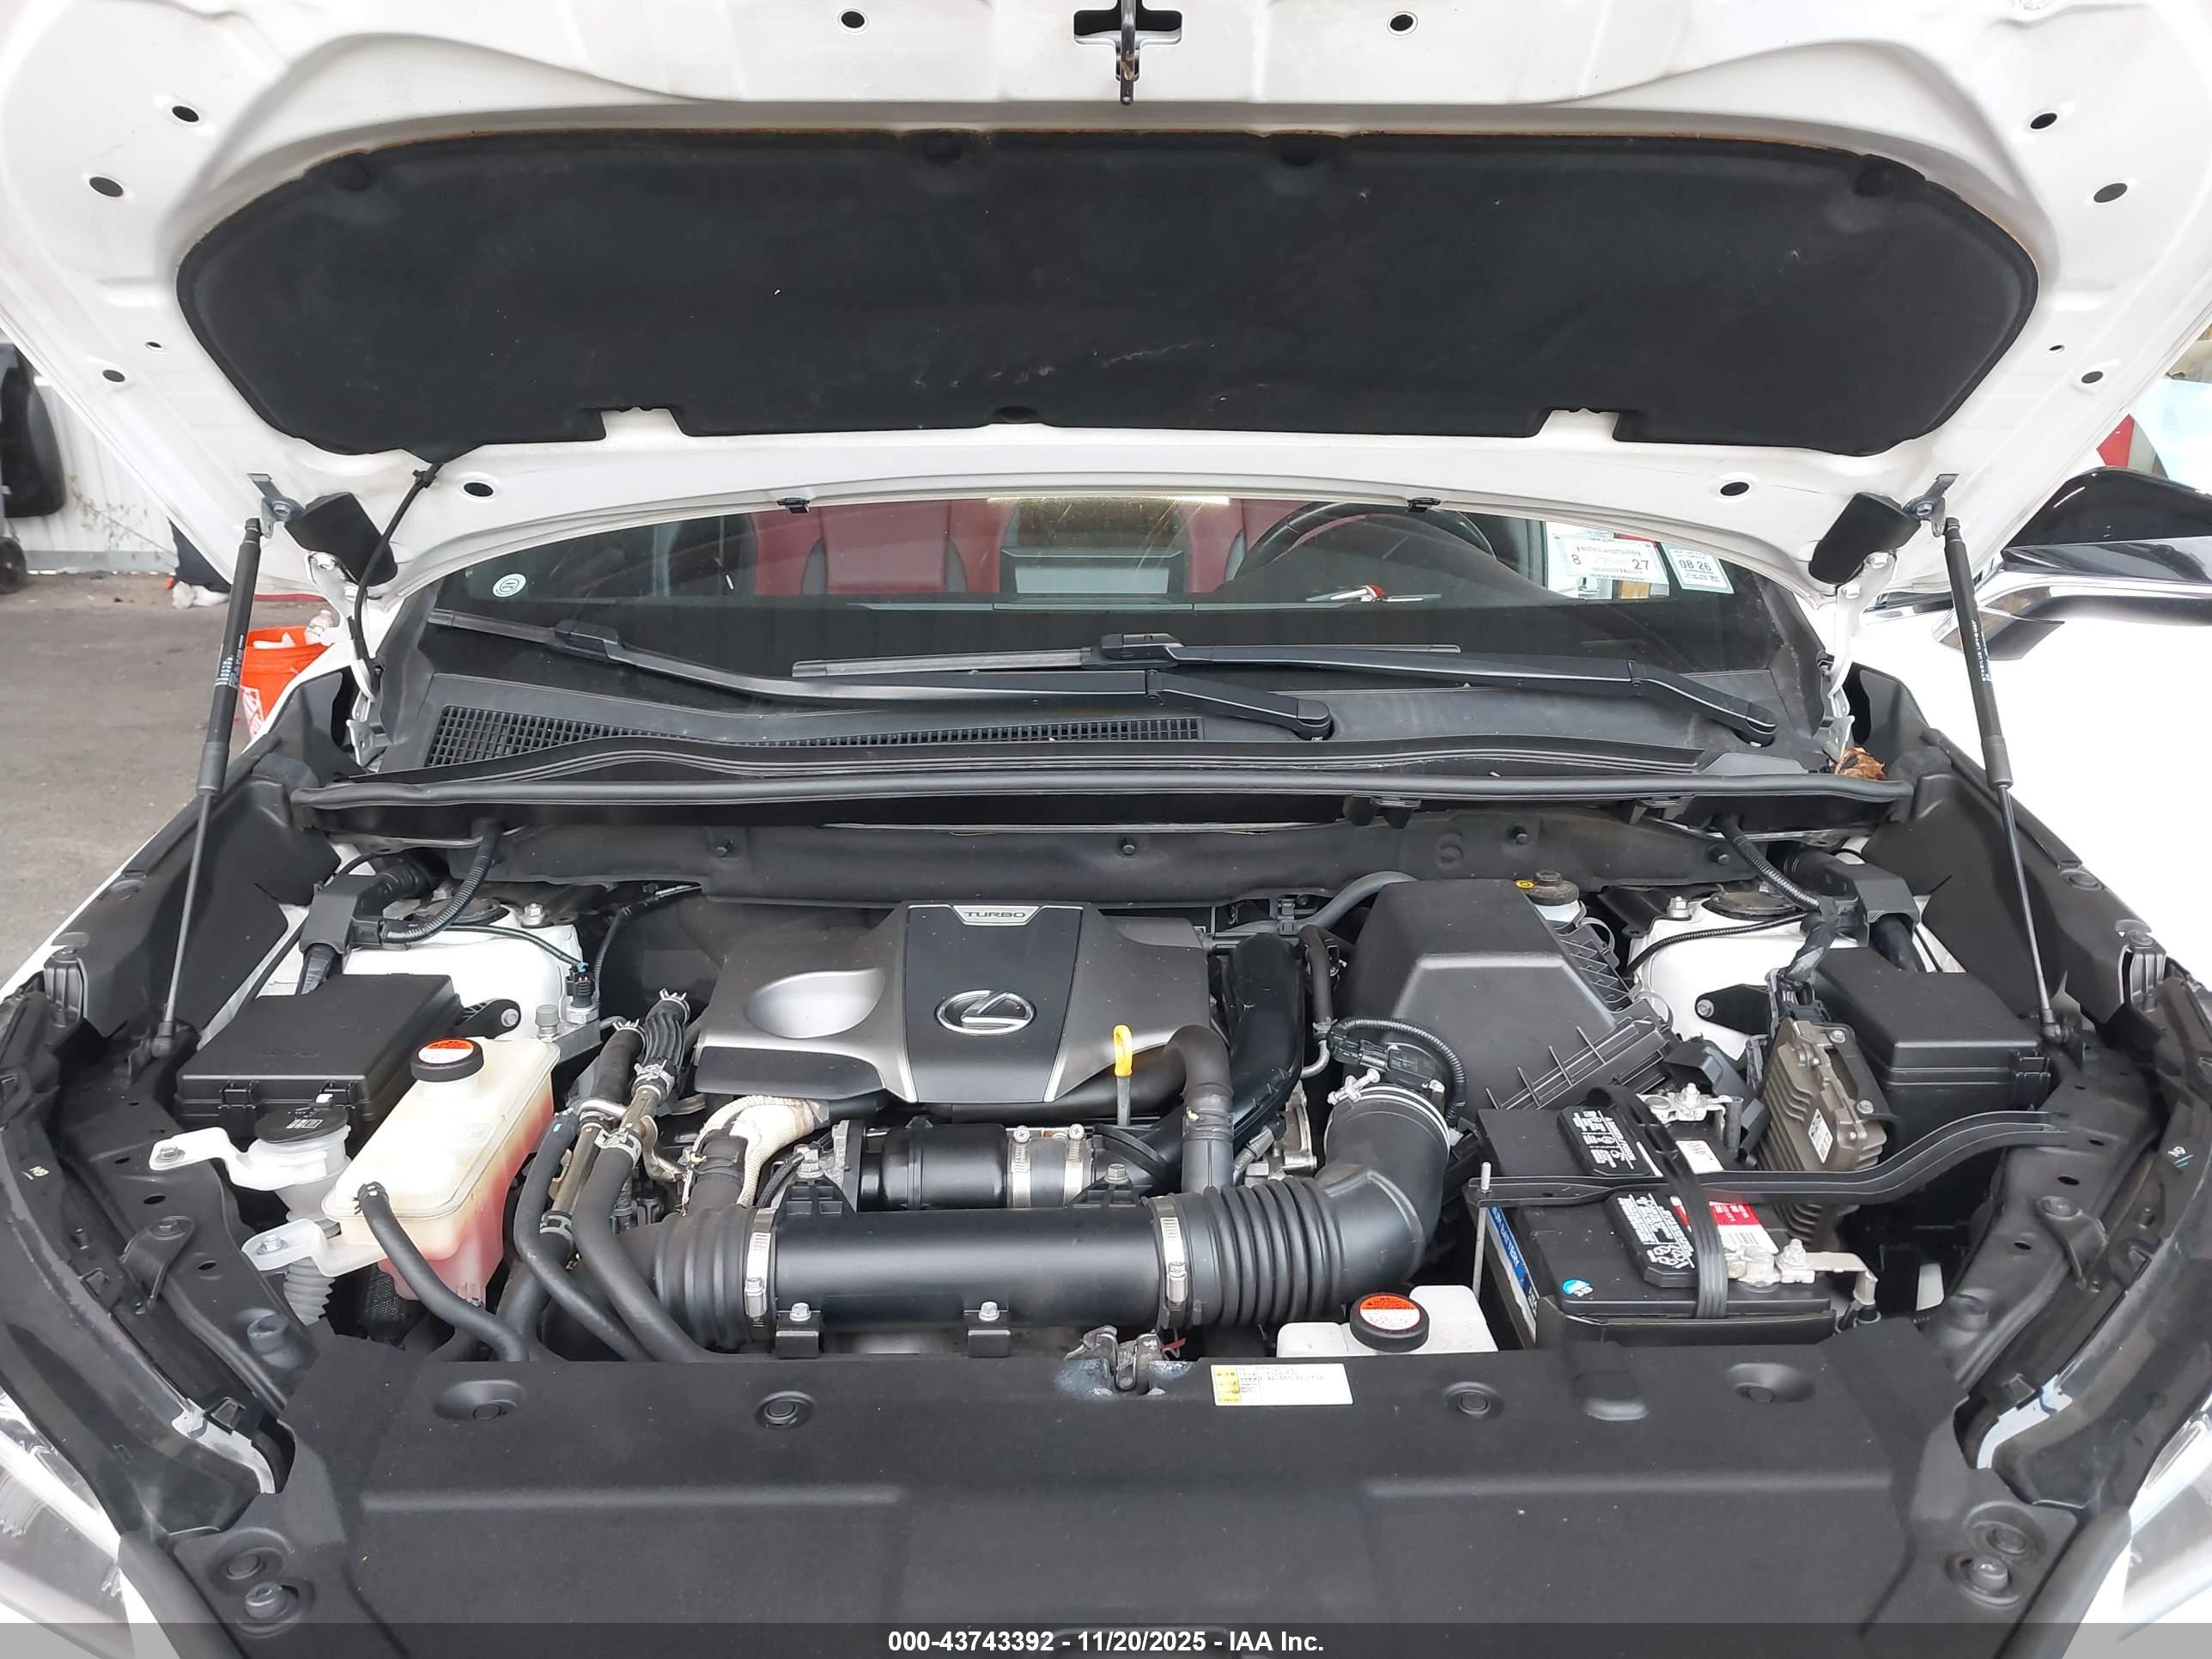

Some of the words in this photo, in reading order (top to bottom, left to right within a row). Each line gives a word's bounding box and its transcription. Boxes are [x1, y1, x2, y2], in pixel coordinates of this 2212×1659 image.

[1571, 554, 1581, 565] 8
[1632, 558, 1650, 570] 27
[1500, 1223, 1520, 1267] BATTERY
